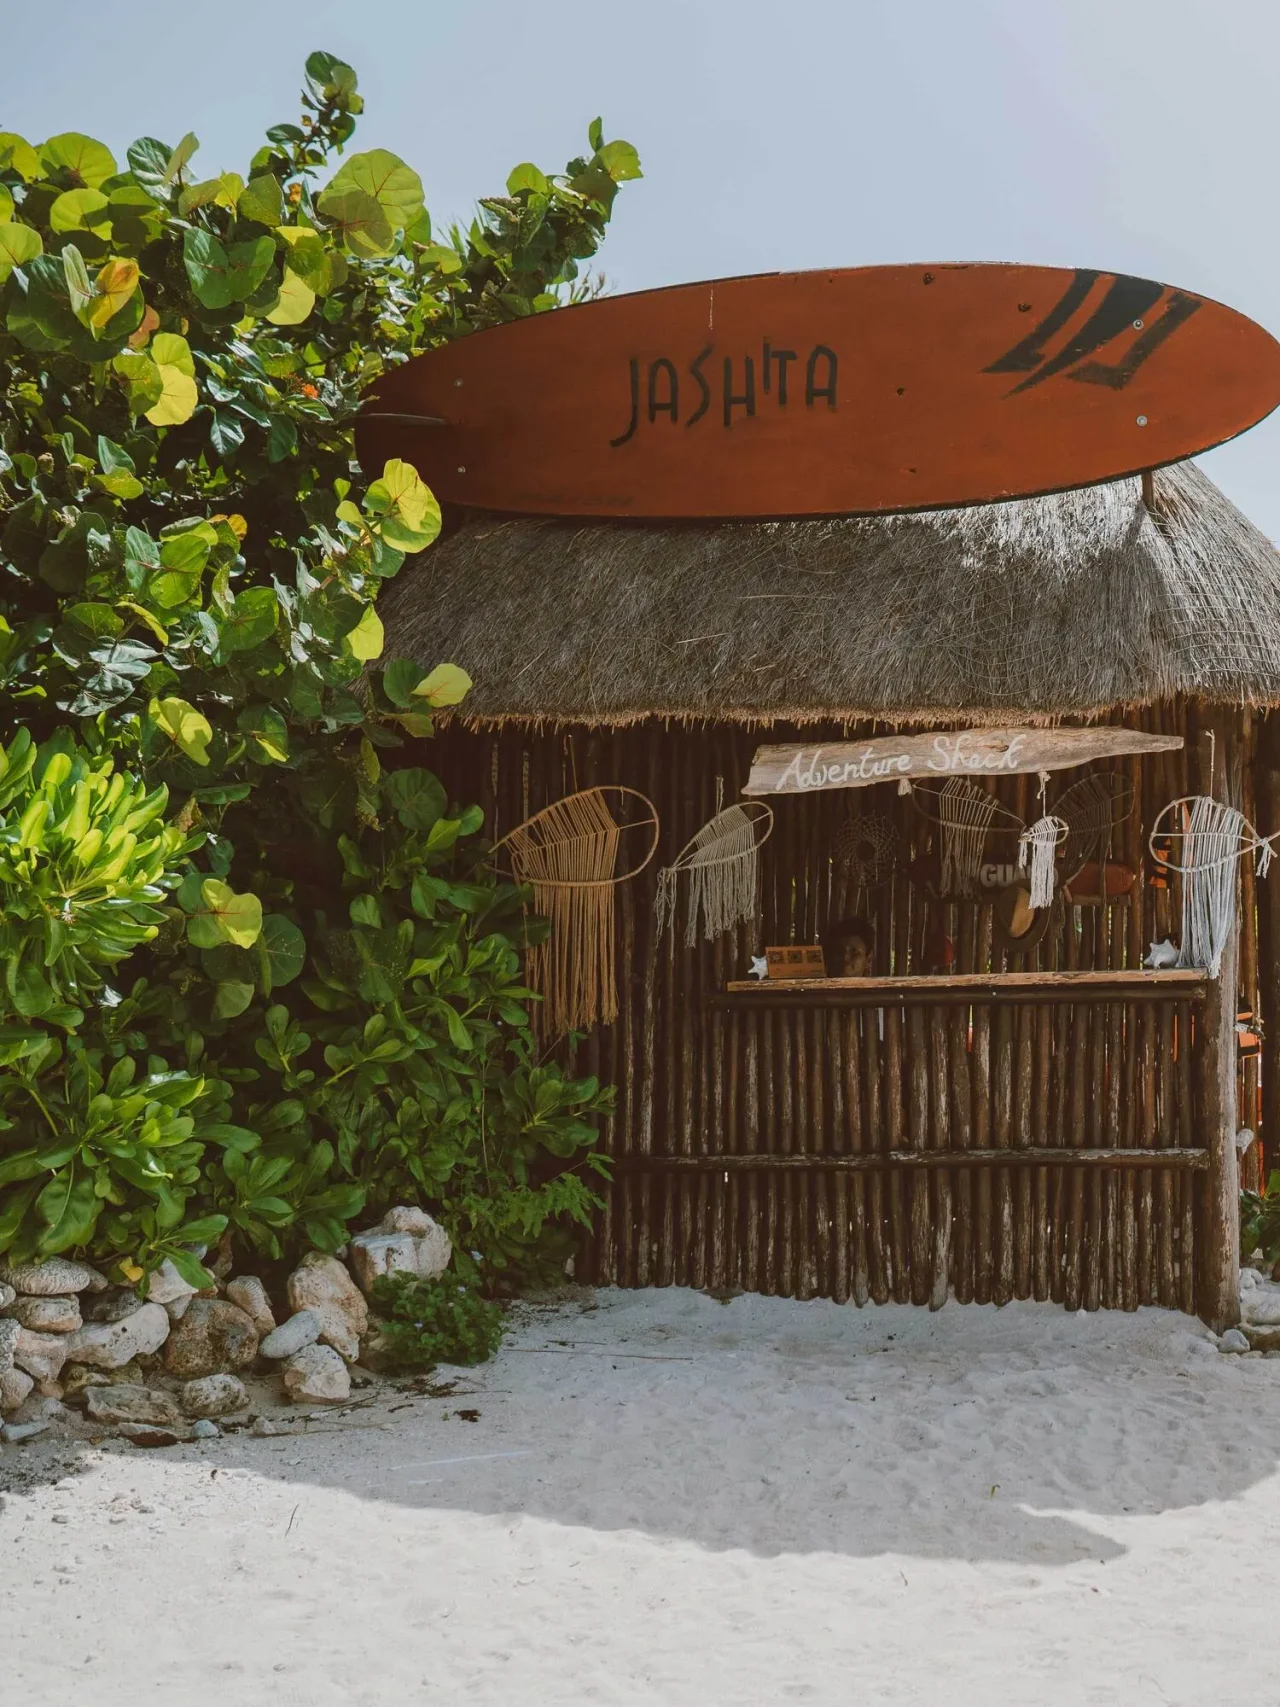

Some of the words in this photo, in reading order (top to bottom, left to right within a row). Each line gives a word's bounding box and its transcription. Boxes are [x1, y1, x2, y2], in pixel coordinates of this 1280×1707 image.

[609, 336, 838, 448] JASHITA
[776, 746, 912, 790] Adventure
[927, 733, 1027, 771] Shack
[980, 863, 1059, 888] GUA
